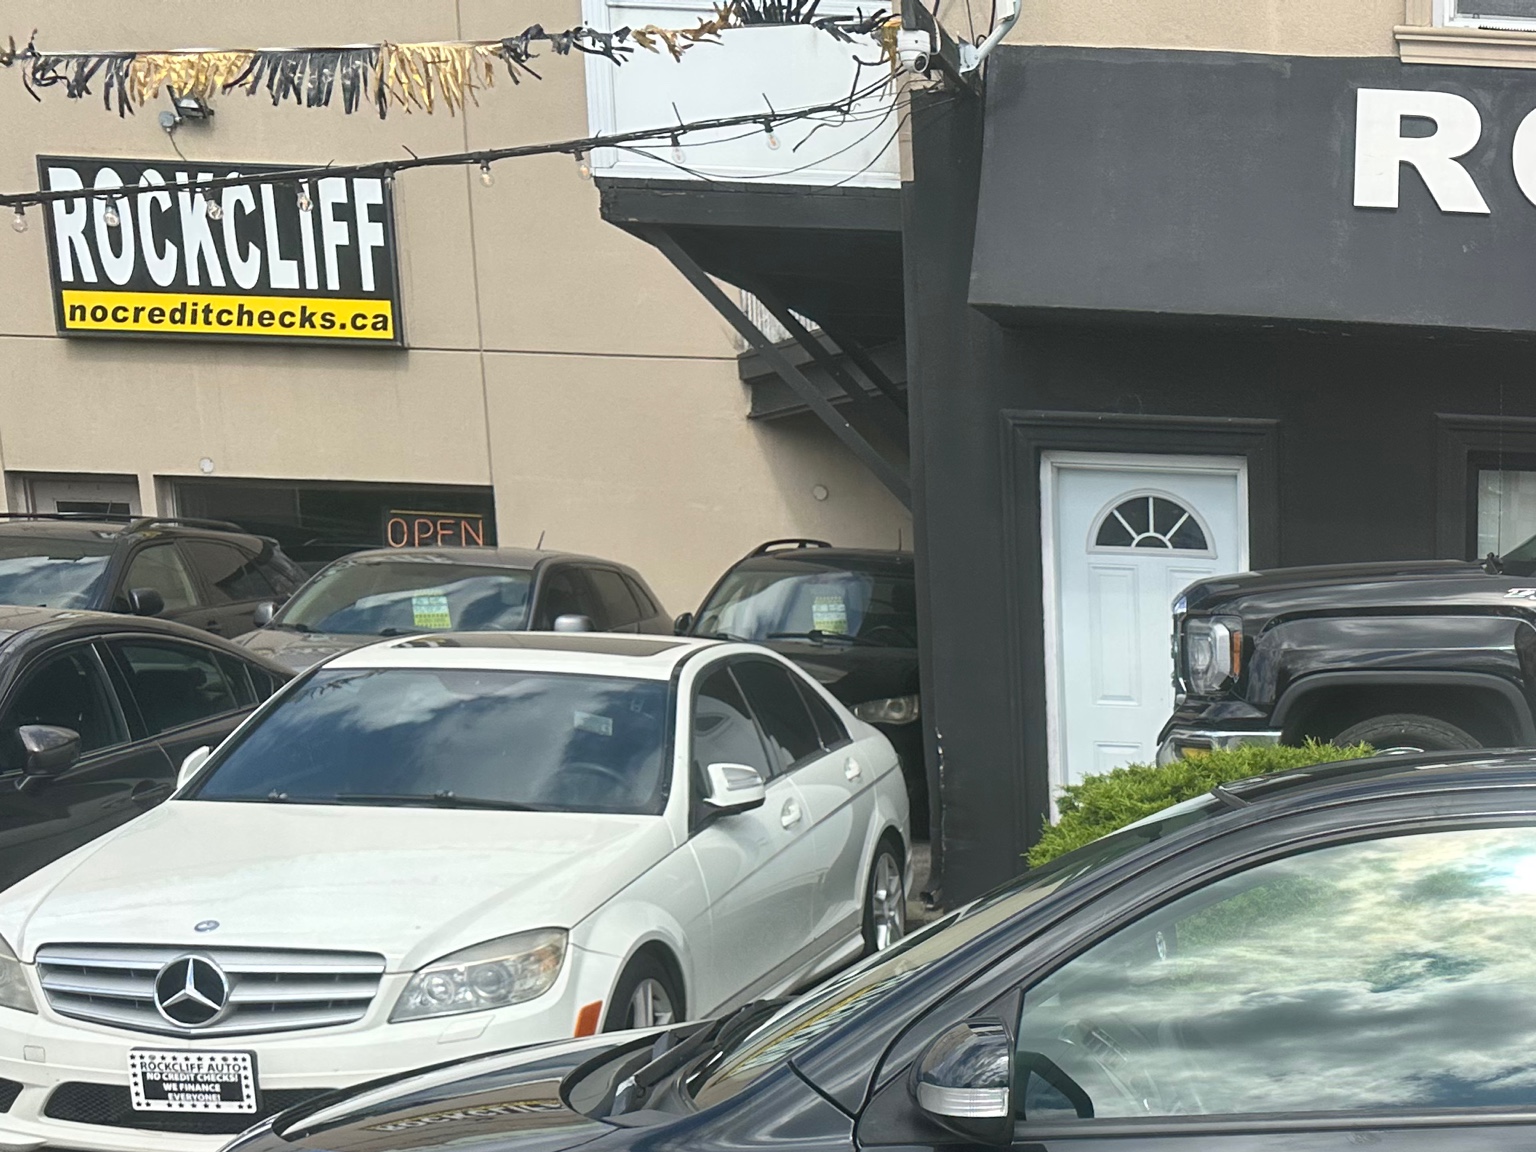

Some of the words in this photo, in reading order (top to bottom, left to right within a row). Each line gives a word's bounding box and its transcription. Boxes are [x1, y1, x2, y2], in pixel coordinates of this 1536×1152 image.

[47, 166, 386, 292] ROCKCLIFF
[68, 300, 390, 332] nocreditchecks.ca
[387, 517, 484, 548] OPEN
[140, 1061, 204, 1073] ROCKCLIFF
[207, 1063, 241, 1073] AUTO
[146, 1072, 161, 1081] NO
[162, 1072, 196, 1082] CREDIT
[162, 1082, 179, 1092] WE
[180, 1083, 222, 1093] FINANCE
